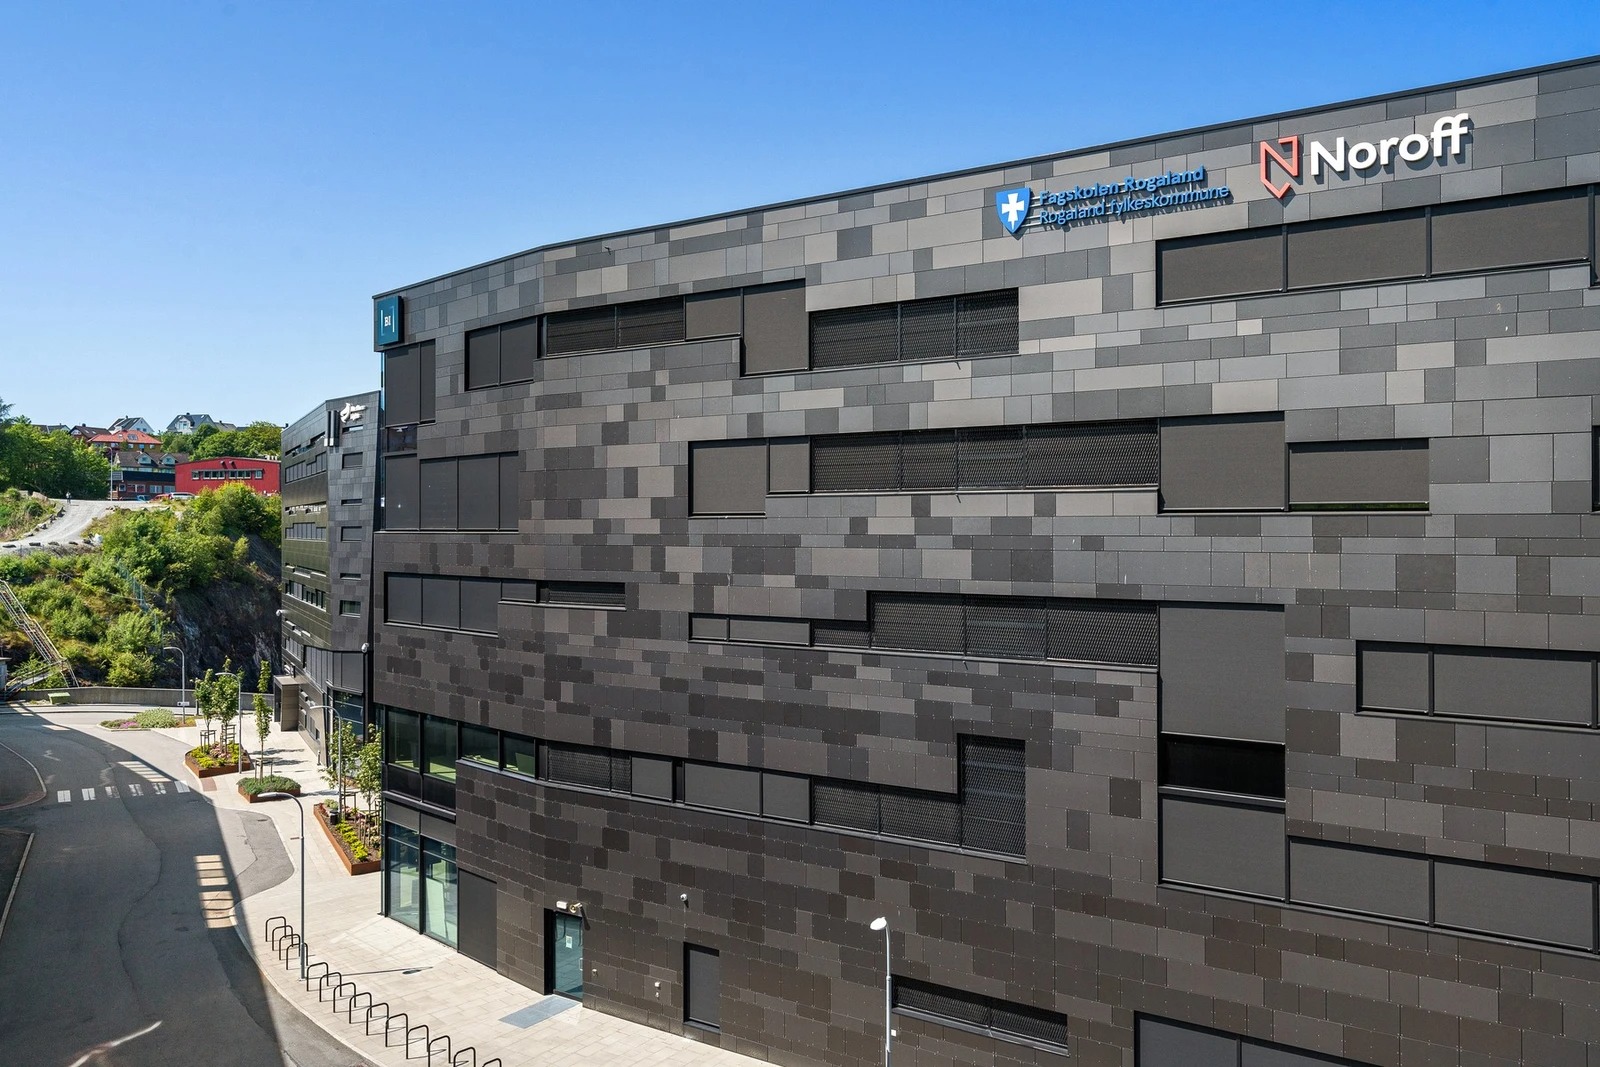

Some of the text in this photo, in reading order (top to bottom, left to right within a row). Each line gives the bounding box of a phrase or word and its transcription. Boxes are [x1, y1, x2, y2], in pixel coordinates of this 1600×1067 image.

[1310, 113, 1469, 176] Noroff
[1039, 164, 1206, 206] Fagskolen Rogaland
[1039, 185, 1230, 225] Rogaland fylkeskommune
